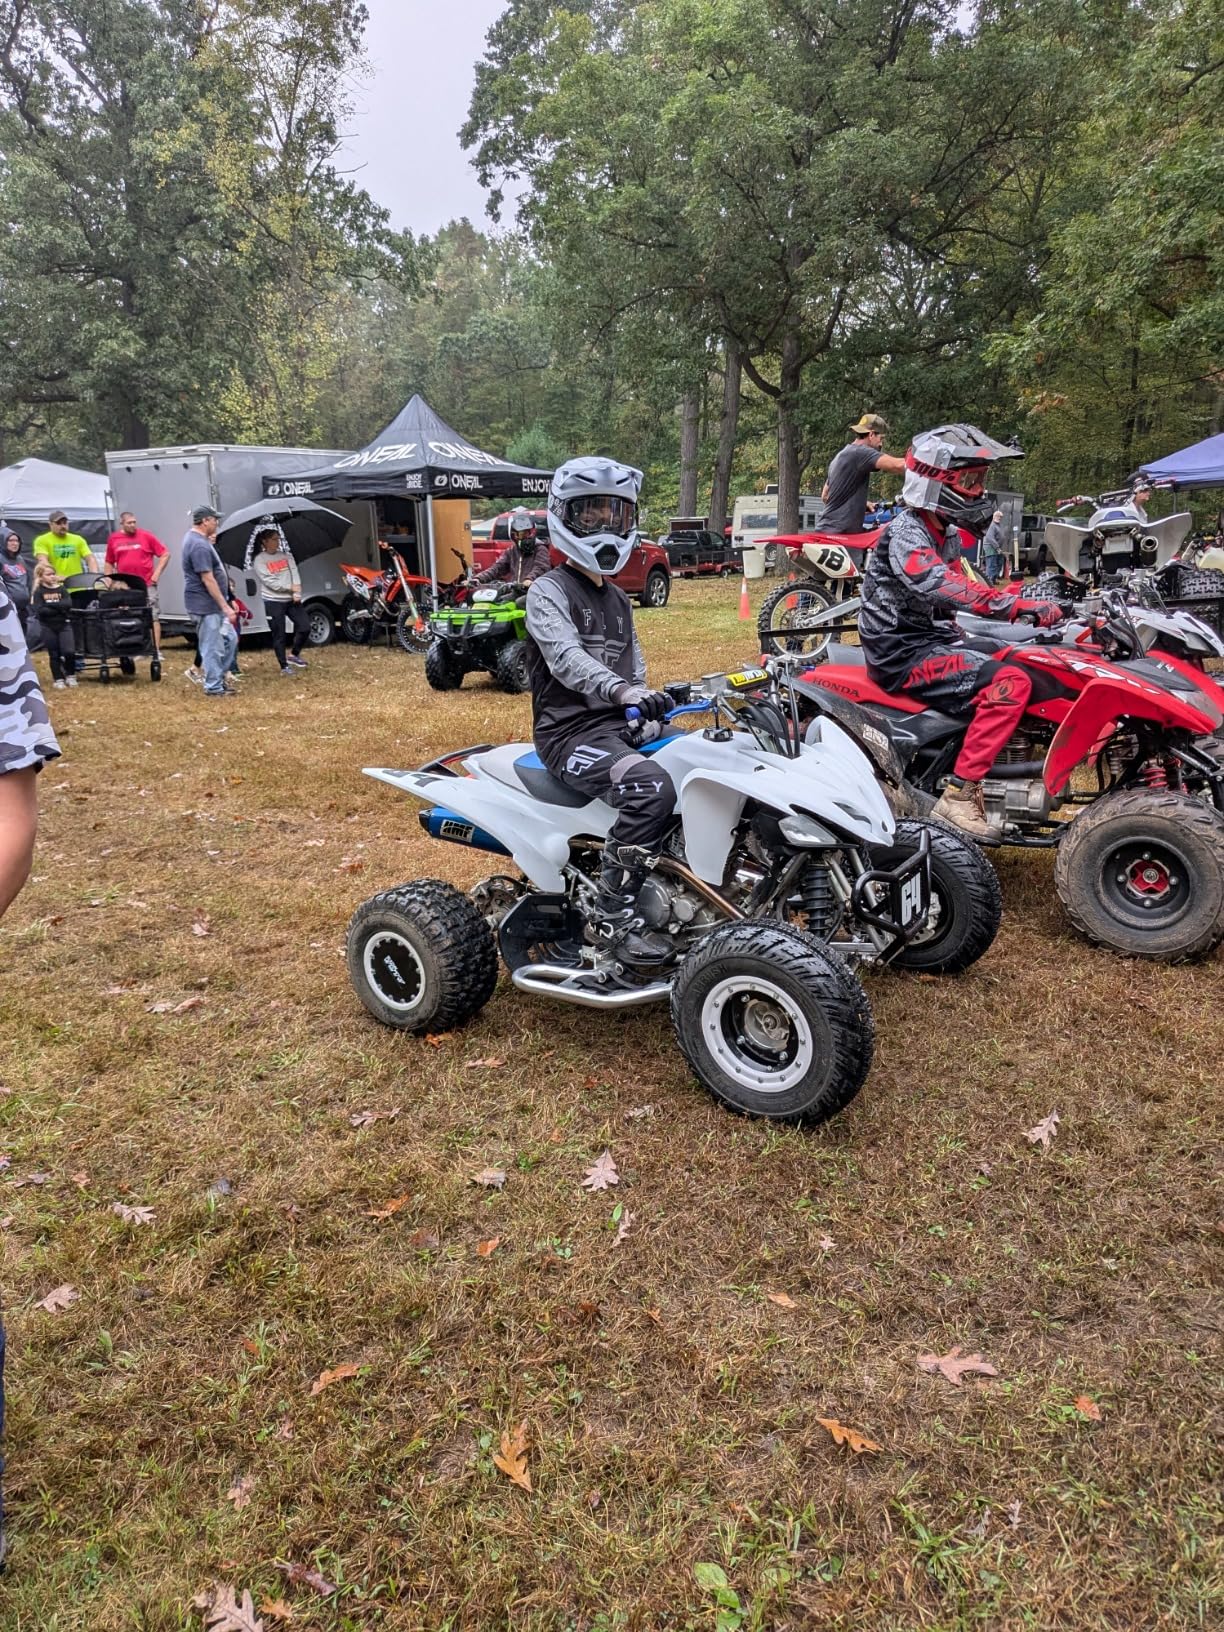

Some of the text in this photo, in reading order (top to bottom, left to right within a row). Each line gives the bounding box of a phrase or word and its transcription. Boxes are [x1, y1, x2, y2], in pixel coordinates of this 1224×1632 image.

[913, 461, 956, 482] 100%
[521, 478, 550, 493] ENJOY
[816, 548, 845, 571] 18
[812, 677, 861, 698] HONDA
[618, 781, 664, 794] FLY
[442, 820, 473, 838] HMF
[901, 871, 921, 926] 64
